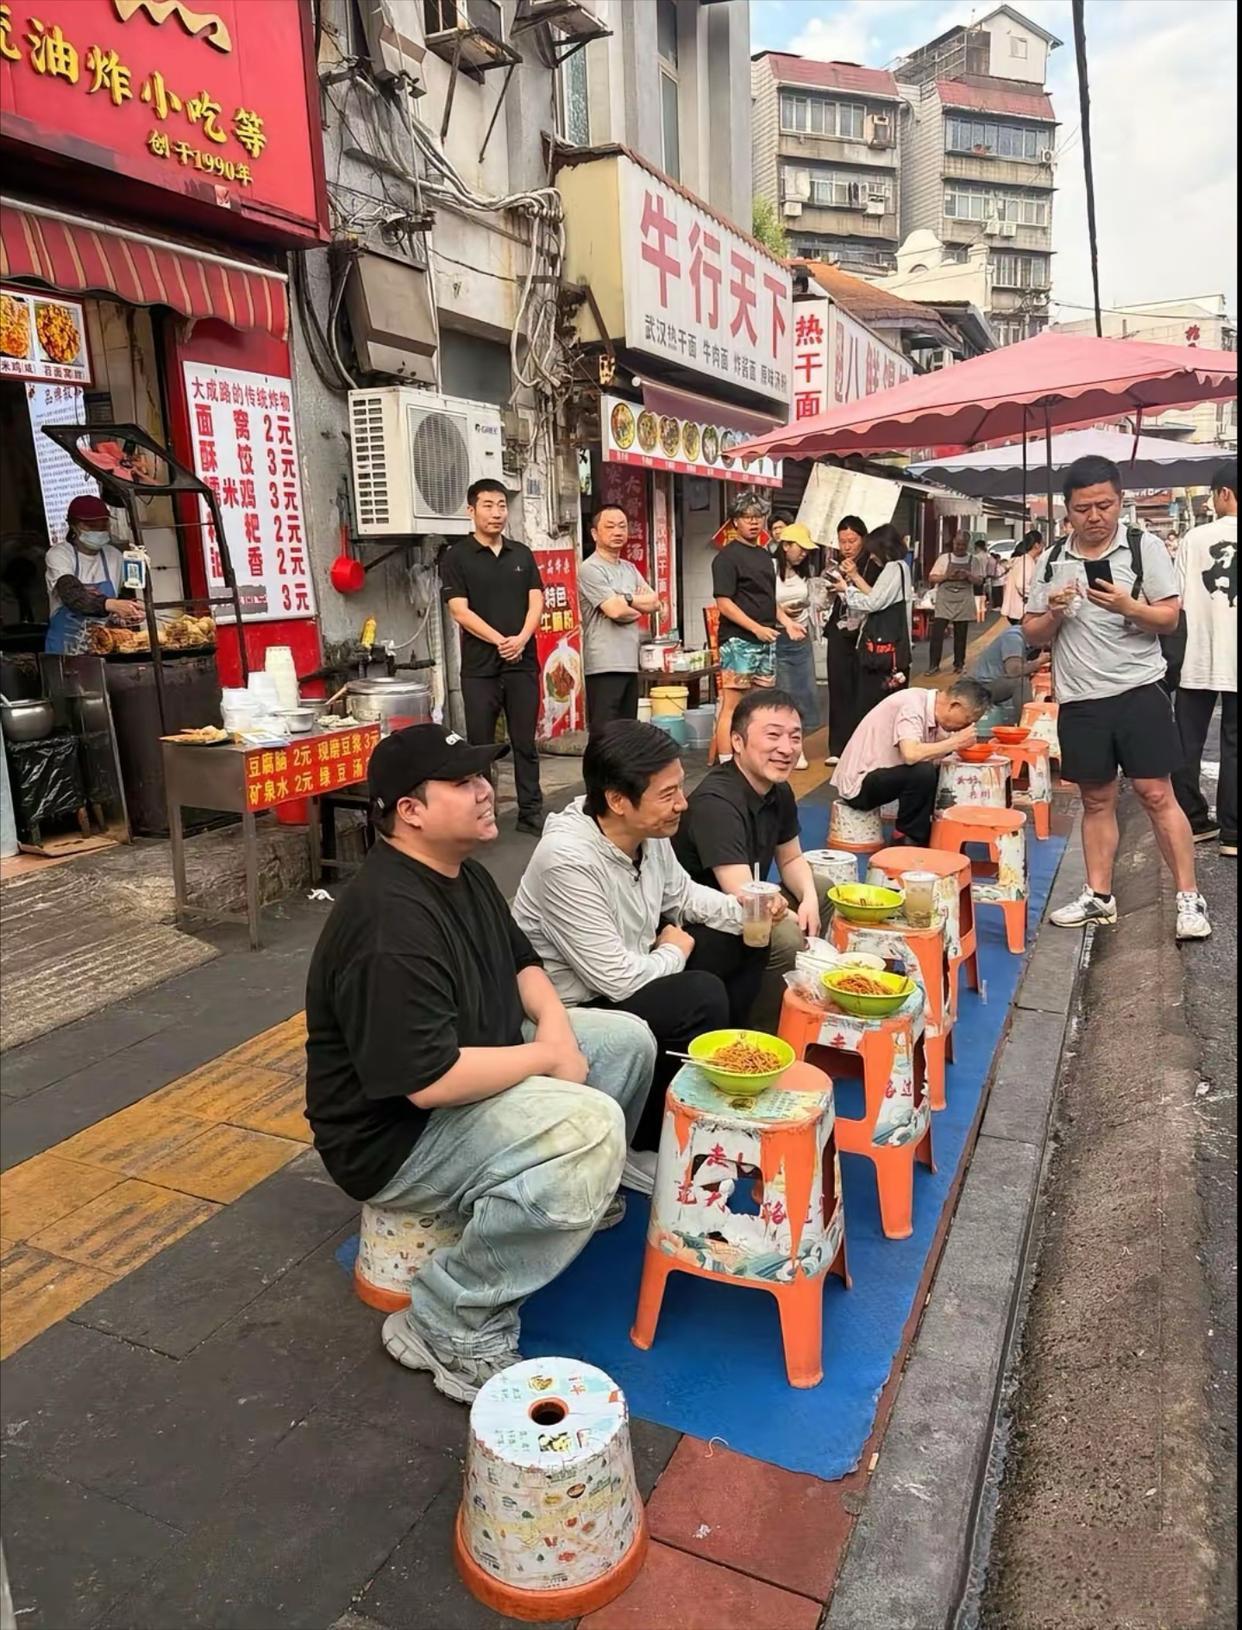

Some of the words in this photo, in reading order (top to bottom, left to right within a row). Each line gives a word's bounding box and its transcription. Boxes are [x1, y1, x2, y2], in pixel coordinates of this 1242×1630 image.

[640, 190, 787, 360] 牛行天下
[645, 314, 697, 359] 武汉热干面
[703, 340, 728, 371] 牛肉面
[734, 352, 756, 382] 炸酱面
[795, 314, 823, 421] 热干面
[192, 376, 291, 412] 大成路的传统炸物
[263, 414, 293, 445] 2元
[267, 448, 296, 478] 3元
[269, 481, 298, 511] 3元
[274, 514, 302, 543] 2元
[277, 547, 305, 575] 2元
[281, 583, 309, 611] 3元
[544, 586, 567, 608] 特色
[249, 750, 288, 778] 豆腐脑
[293, 745, 312, 767] 2元
[318, 733, 362, 761] 现磨豆浆
[249, 777, 288, 805] 矿泉水
[295, 771, 313, 792] 2元
